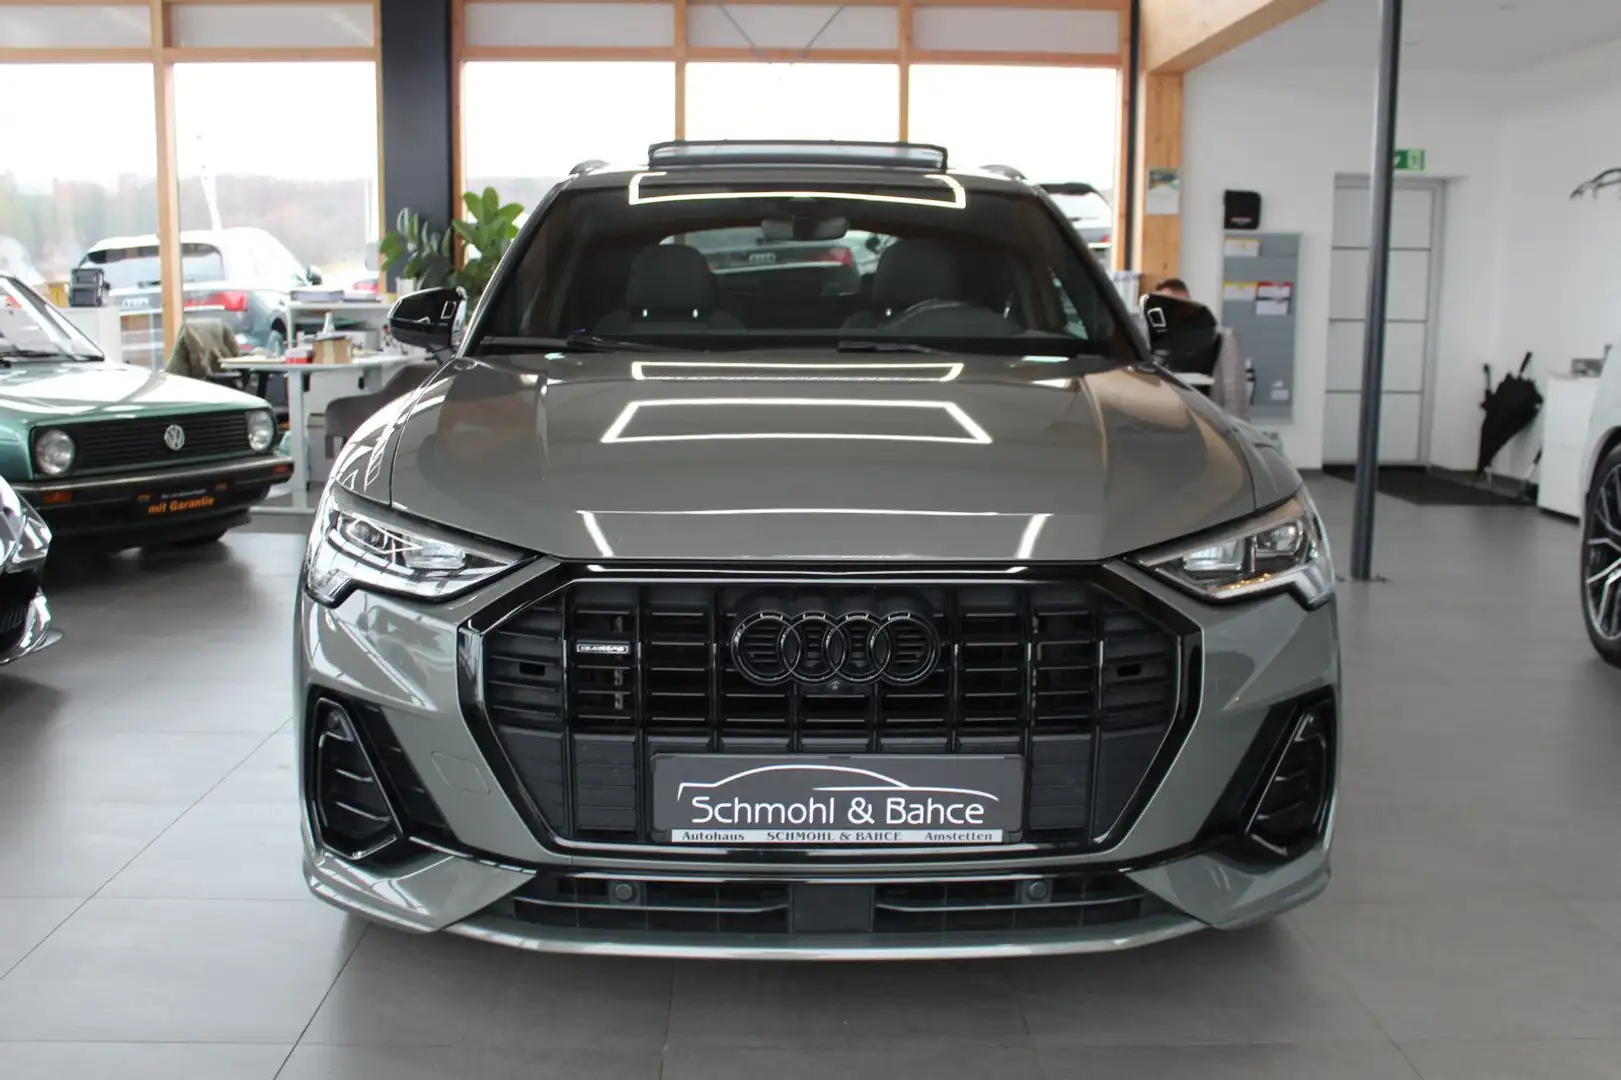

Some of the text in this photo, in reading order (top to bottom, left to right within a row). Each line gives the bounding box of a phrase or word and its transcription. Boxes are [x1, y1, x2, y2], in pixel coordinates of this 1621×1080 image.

[147, 495, 215, 514] mit Garantie
[691, 796, 985, 824] Schmohl & Bahce
[682, 831, 993, 841] Autohaus SCHMOHL & BAHCE Amstetten
